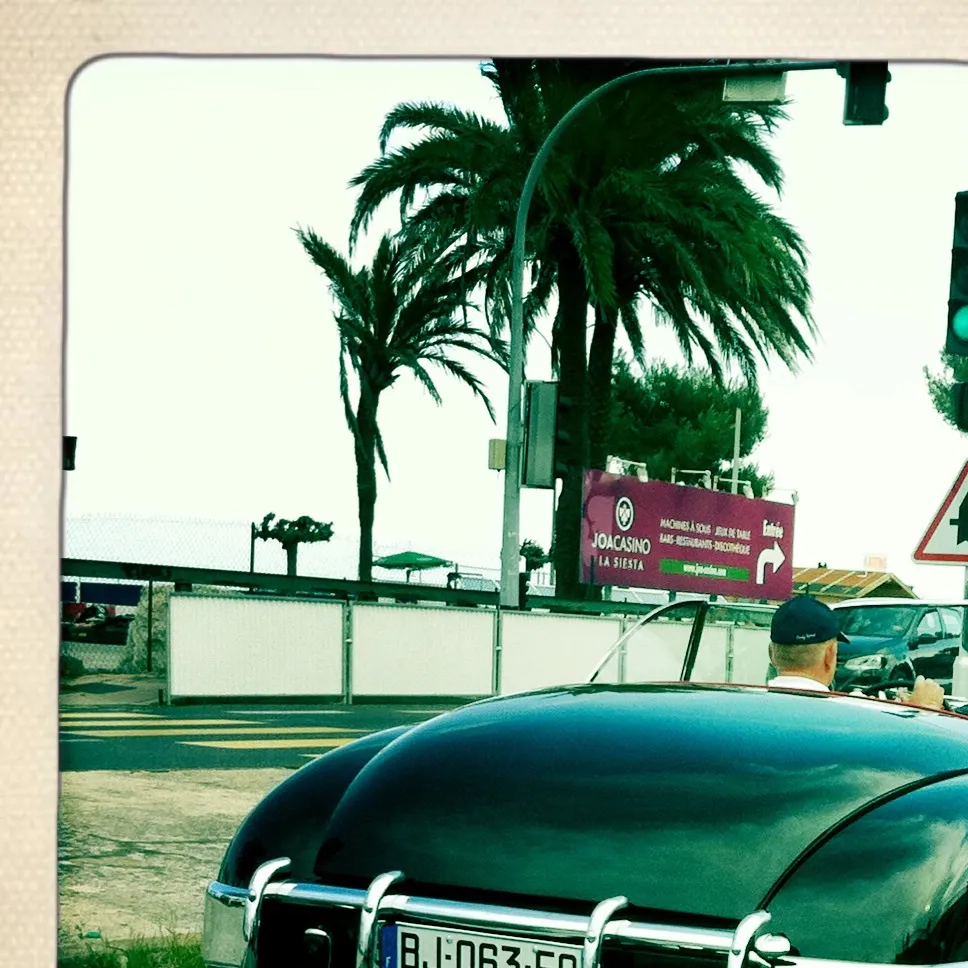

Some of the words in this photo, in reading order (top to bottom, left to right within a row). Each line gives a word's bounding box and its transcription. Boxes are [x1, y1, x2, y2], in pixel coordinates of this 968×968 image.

[762, 519, 784, 539] Entrée
[599, 555, 610, 567] LA
[613, 556, 644, 571] SIESTA
